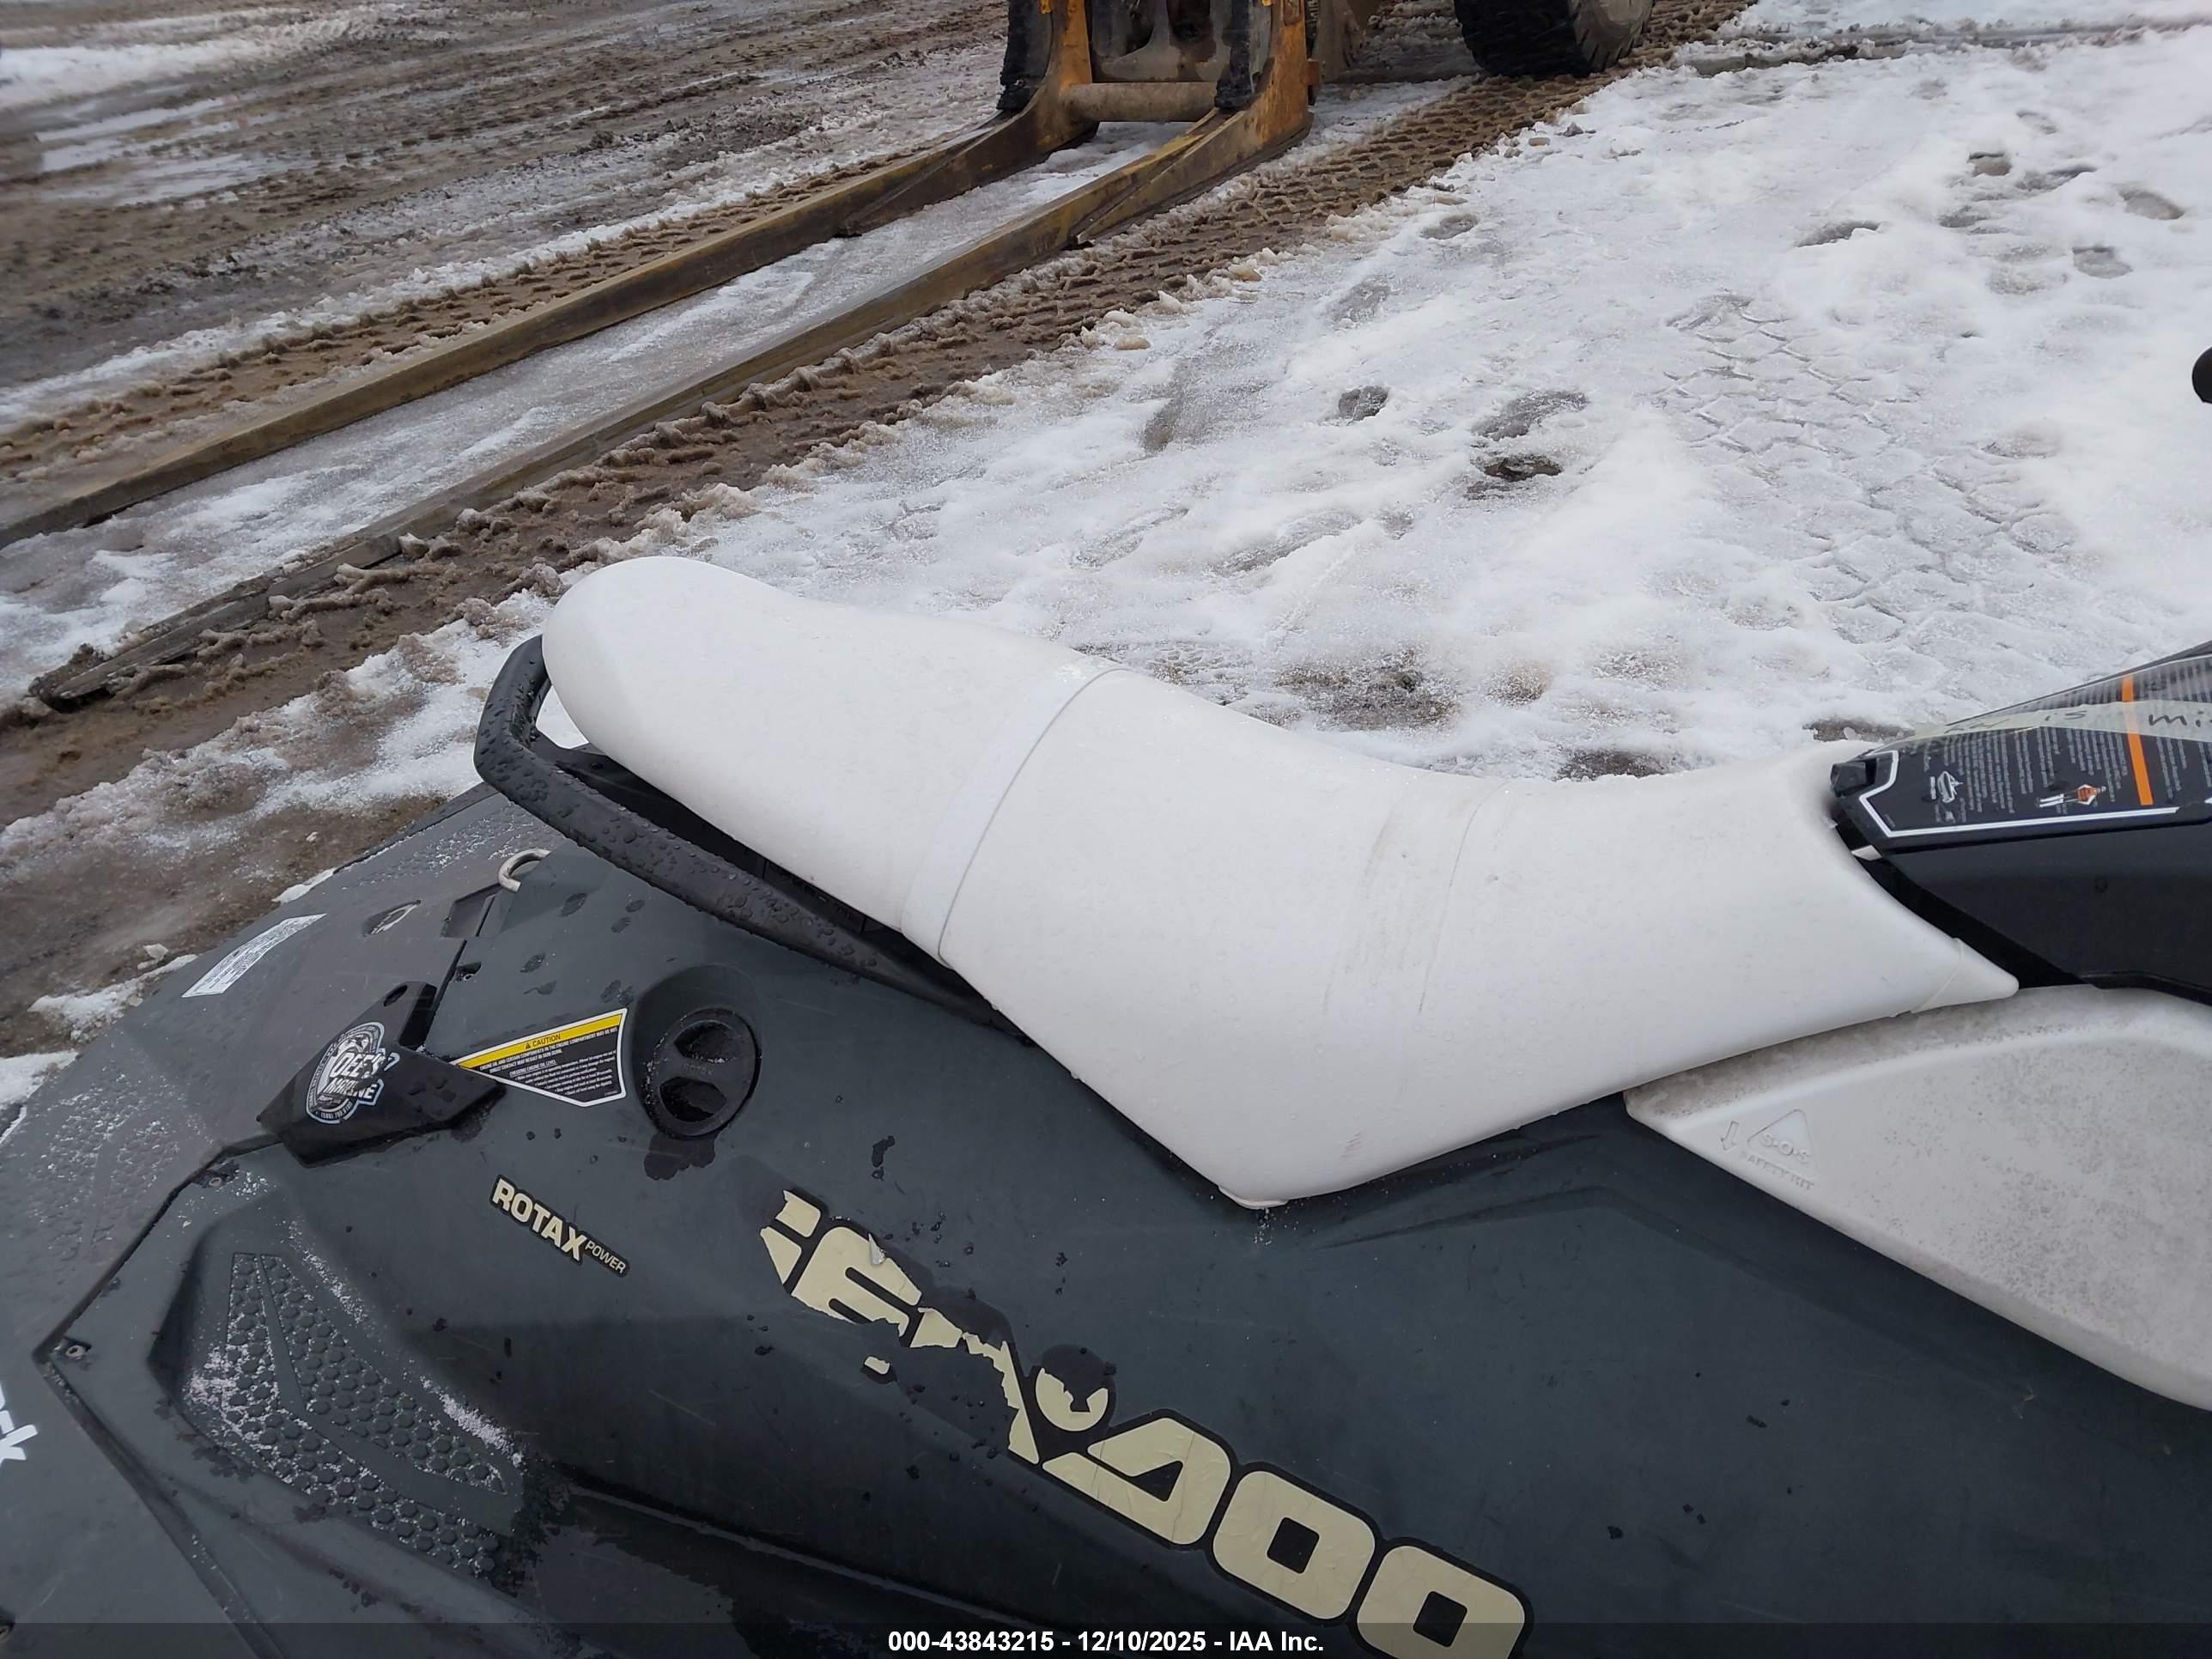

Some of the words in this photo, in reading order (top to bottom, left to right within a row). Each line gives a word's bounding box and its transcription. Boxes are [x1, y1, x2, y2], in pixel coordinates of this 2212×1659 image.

[2148, 710, 2212, 727] mi
[532, 1034, 561, 1048] CAUTION
[492, 1178, 587, 1261] ROTAX
[585, 1241, 626, 1274] POWER
